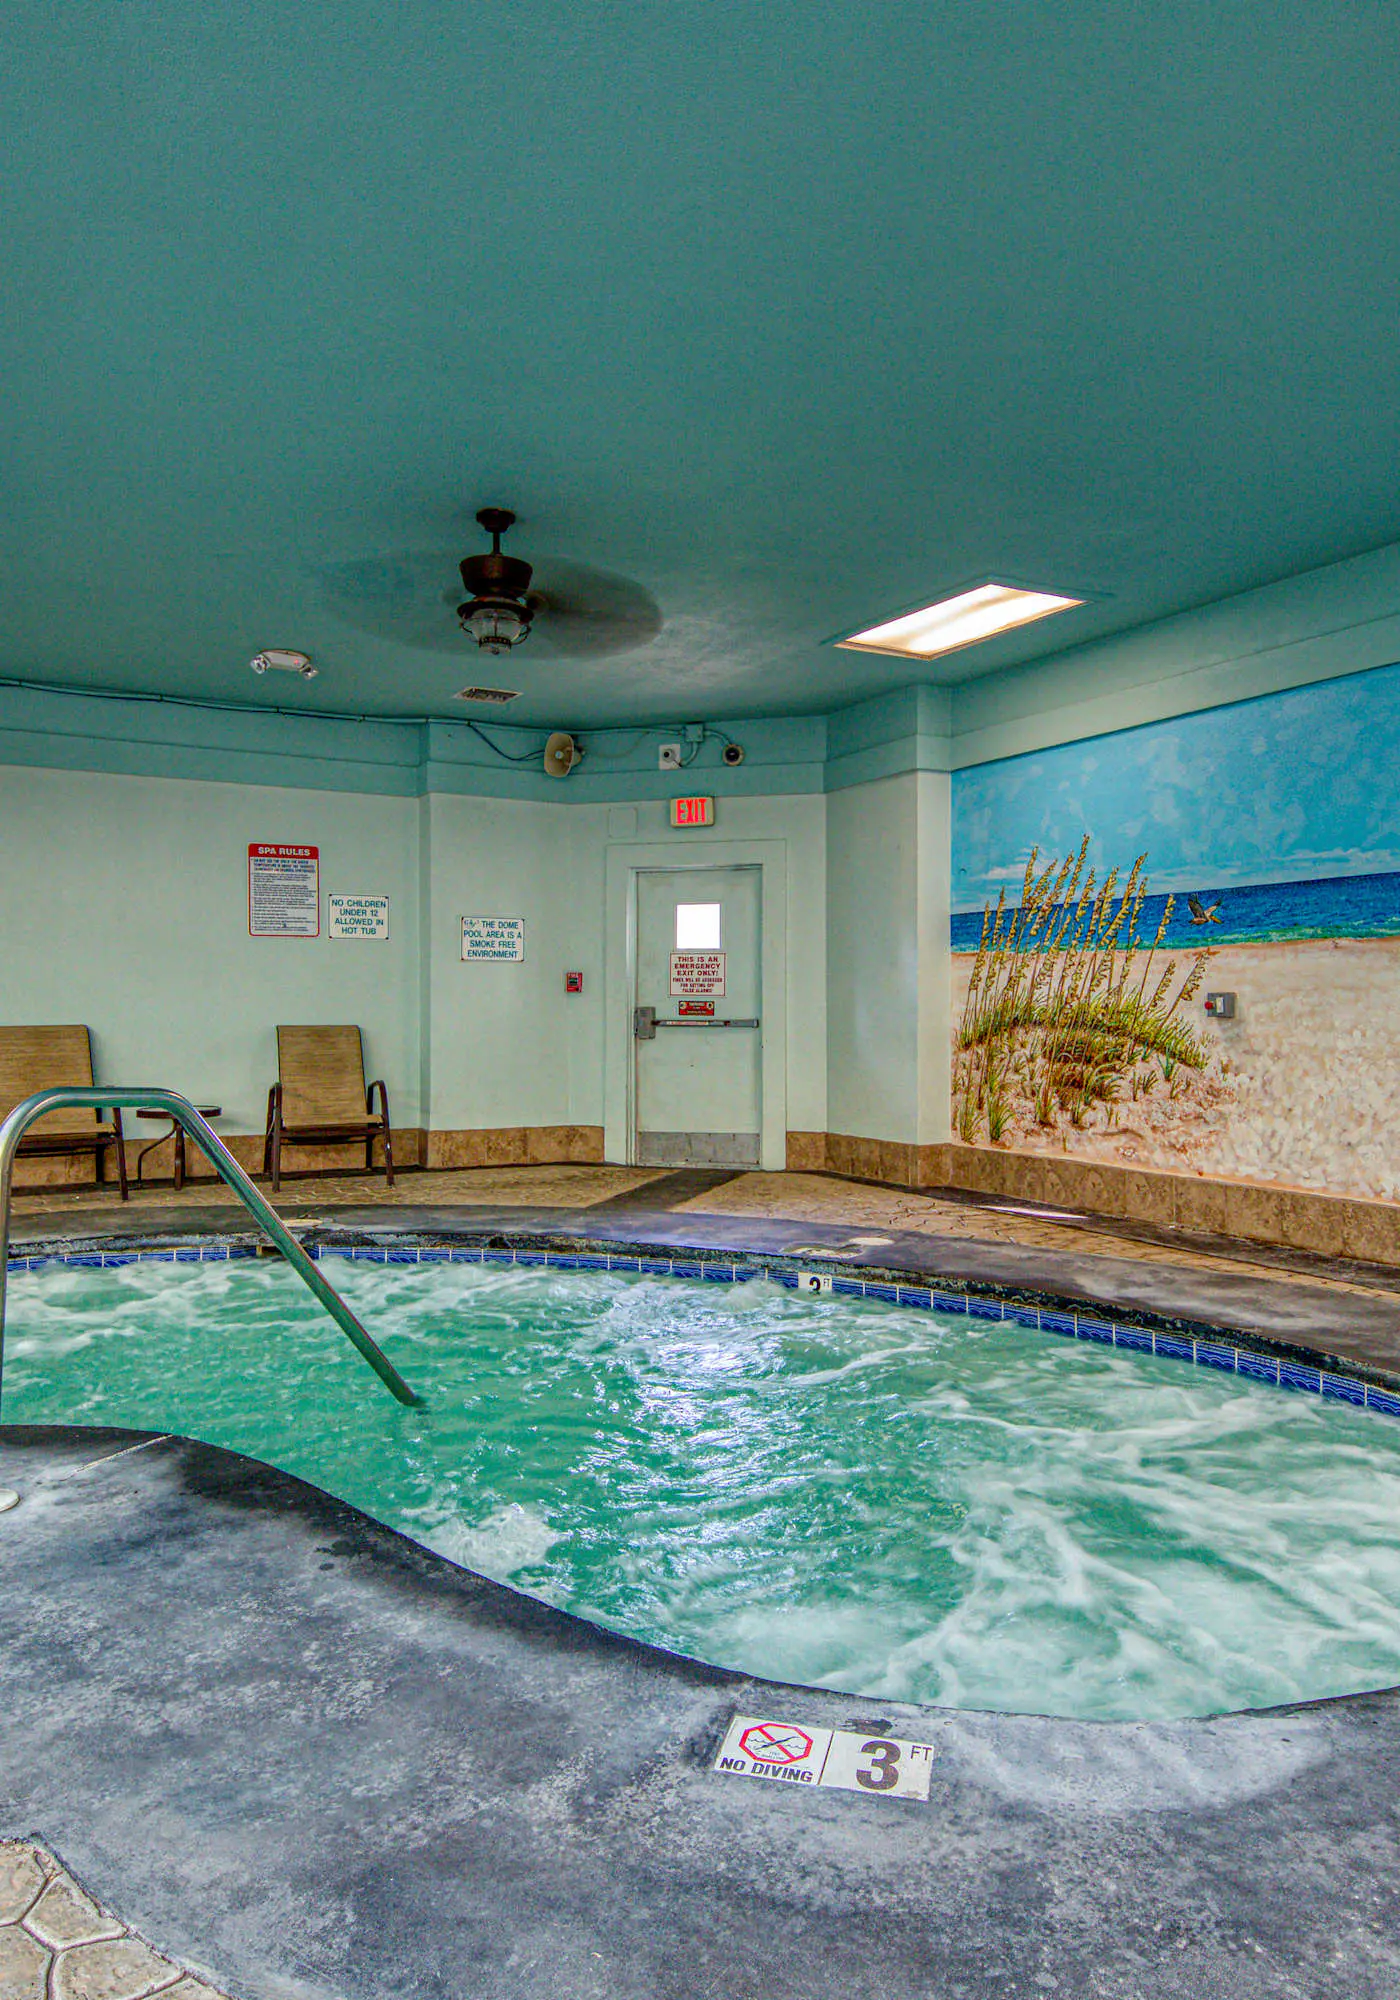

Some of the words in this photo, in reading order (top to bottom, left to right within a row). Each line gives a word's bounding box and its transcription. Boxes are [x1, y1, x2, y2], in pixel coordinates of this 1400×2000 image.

[676, 798, 707, 824] EXIT
[258, 846, 276, 854] SPA
[279, 847, 311, 856] RULES
[331, 899, 344, 907] NO
[347, 899, 386, 908] CHILDREN
[340, 908, 367, 916] UNDER
[370, 909, 379, 917] 12
[335, 917, 373, 926] ALLOWED
[482, 920, 496, 929] THE
[498, 921, 519, 929] DOME
[341, 927, 358, 935] HOT
[463, 930, 483, 938] POOL
[486, 931, 505, 939] AREA
[507, 931, 515, 939] IS
[517, 931, 522, 939] A
[469, 940, 495, 949] SMOKE
[498, 940, 517, 949] FREE
[467, 949, 519, 959] ENVIRONMENT
[823, 1278, 830, 1288] FT
[856, 1739, 901, 1790] 3
[911, 1745, 932, 1761] FT
[720, 1757, 746, 1771] NO
[751, 1762, 814, 1783] DIVING
